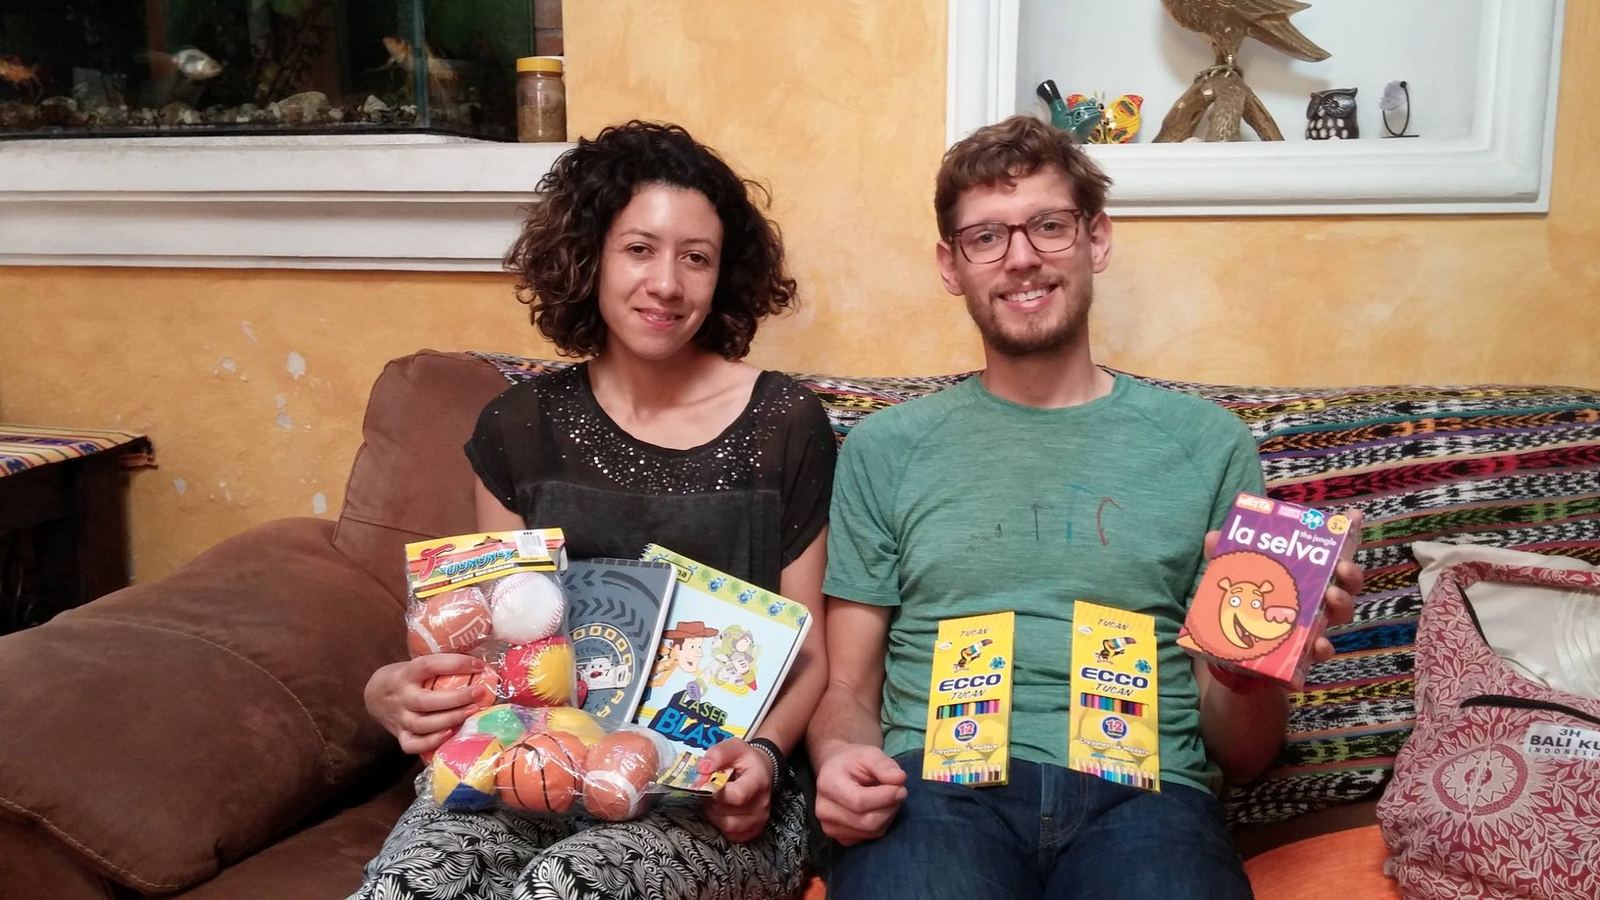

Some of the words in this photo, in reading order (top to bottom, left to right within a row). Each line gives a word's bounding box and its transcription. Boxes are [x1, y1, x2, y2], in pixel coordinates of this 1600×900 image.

[1227, 514, 1256, 545] la
[1257, 529, 1331, 566] selva
[938, 673, 1002, 692] ECCO
[1081, 667, 1149, 689] ECCO
[951, 689, 987, 700] TUCAN
[1095, 683, 1134, 696] TUCAN
[678, 690, 728, 725] LASER
[1558, 728, 1581, 737] 3H
[1530, 734, 1572, 748] BALI
[1528, 747, 1600, 757] INDONESI
